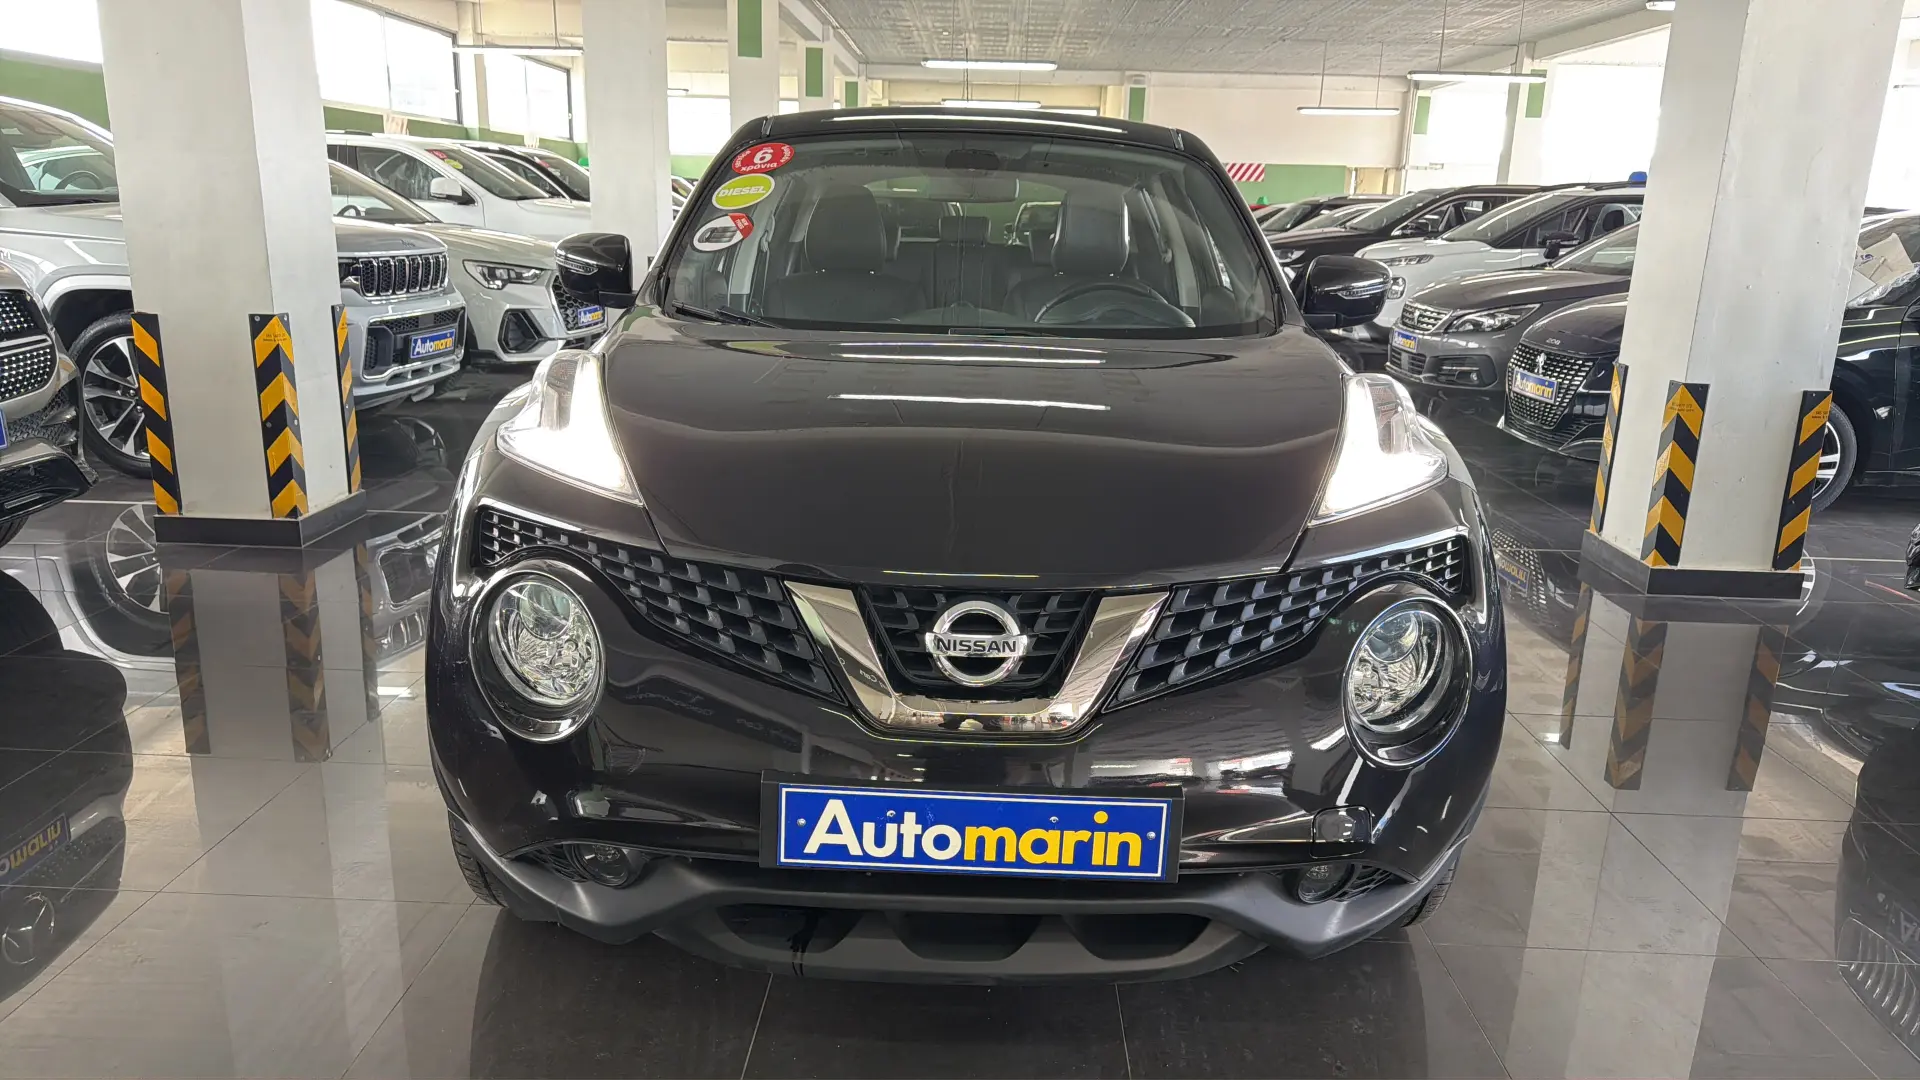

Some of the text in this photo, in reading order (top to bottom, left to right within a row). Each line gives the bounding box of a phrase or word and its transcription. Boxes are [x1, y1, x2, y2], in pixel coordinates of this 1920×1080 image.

[753, 149, 774, 164] 6
[740, 162, 778, 172] χρόνια
[719, 185, 767, 197] DIESEL
[414, 338, 453, 355] Automarin
[1515, 372, 1553, 398] Automarin
[935, 637, 1017, 653] NISSAN
[803, 799, 1142, 867] Automarin
